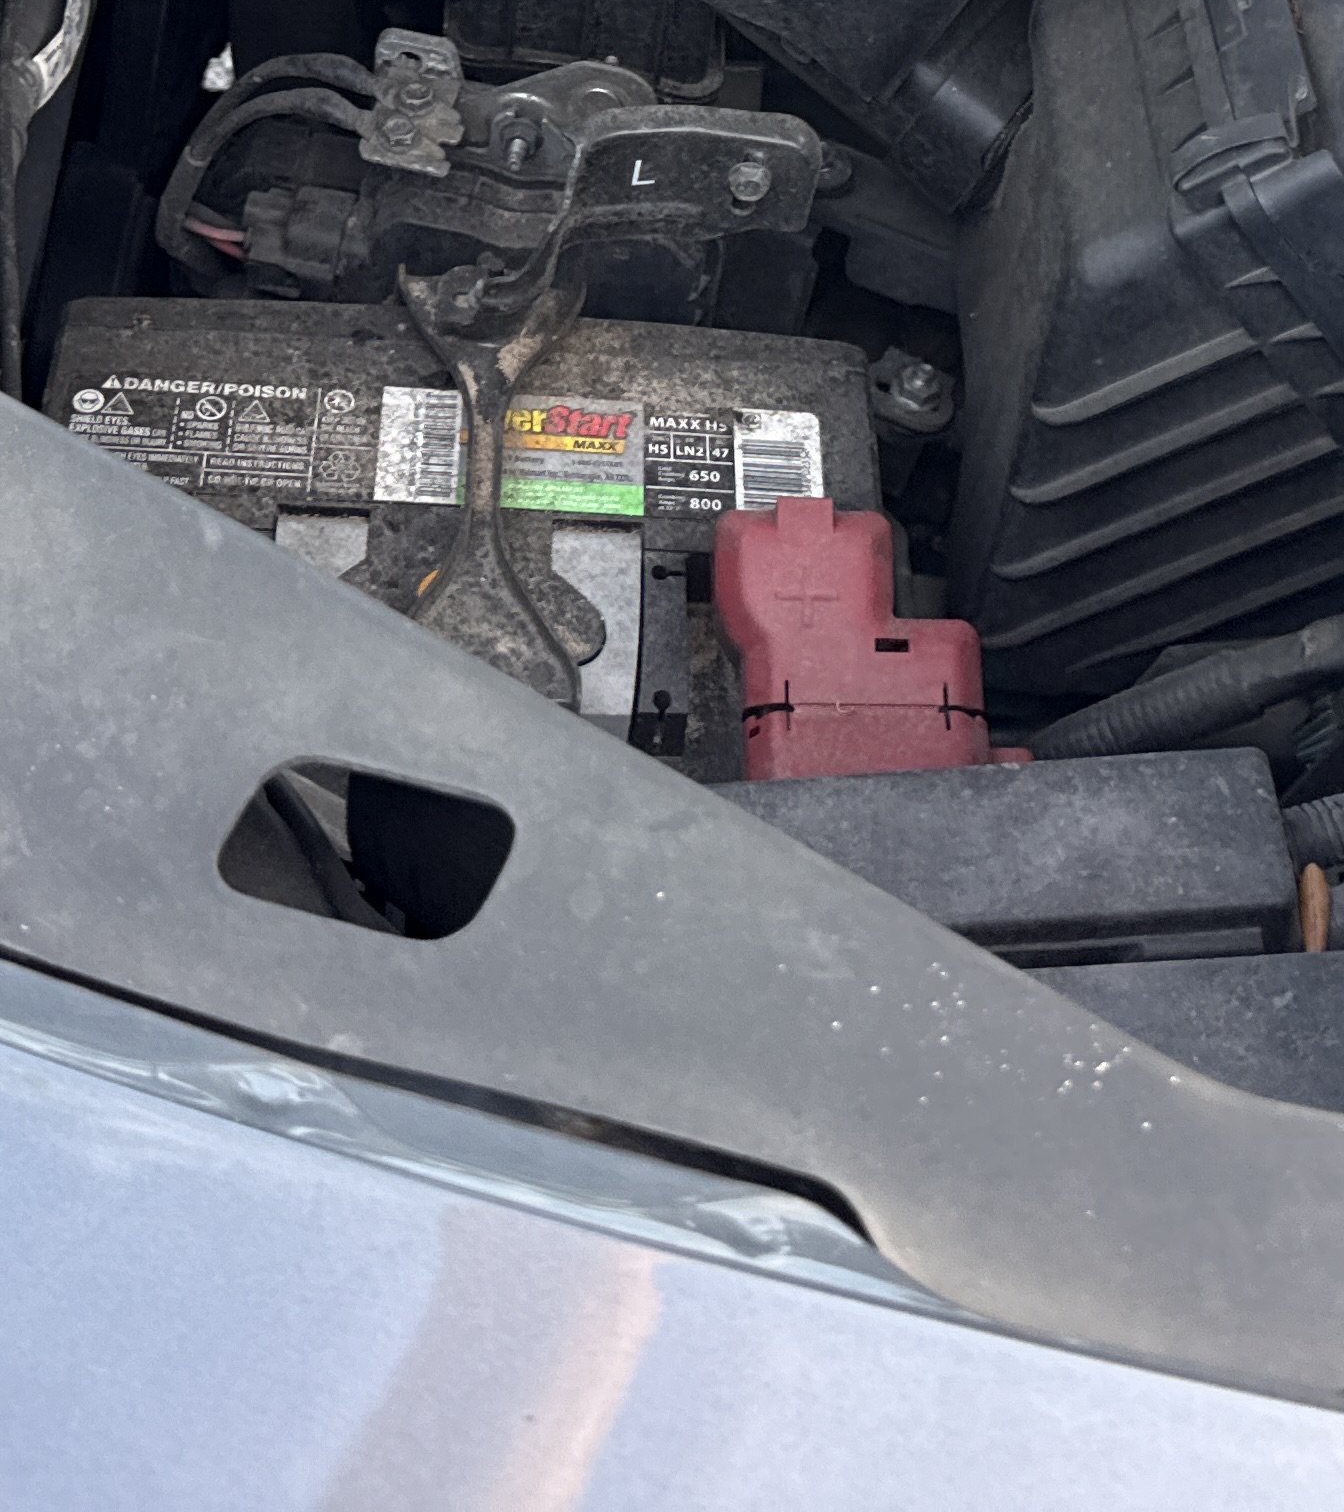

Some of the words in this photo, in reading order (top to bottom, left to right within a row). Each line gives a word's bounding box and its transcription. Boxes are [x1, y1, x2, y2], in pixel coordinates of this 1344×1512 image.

[631, 160, 655, 186] L
[123, 376, 308, 399] DANGER/POISON
[68, 423, 119, 435] EXPLOSIVE
[120, 426, 151, 437] GASES
[648, 416, 701, 430] MAXX
[572, 439, 618, 452] MAXX
[647, 443, 669, 455] H5
[675, 445, 705, 457] LN2
[711, 447, 730, 459] 47
[688, 469, 721, 483] 650
[689, 497, 722, 511] 800
